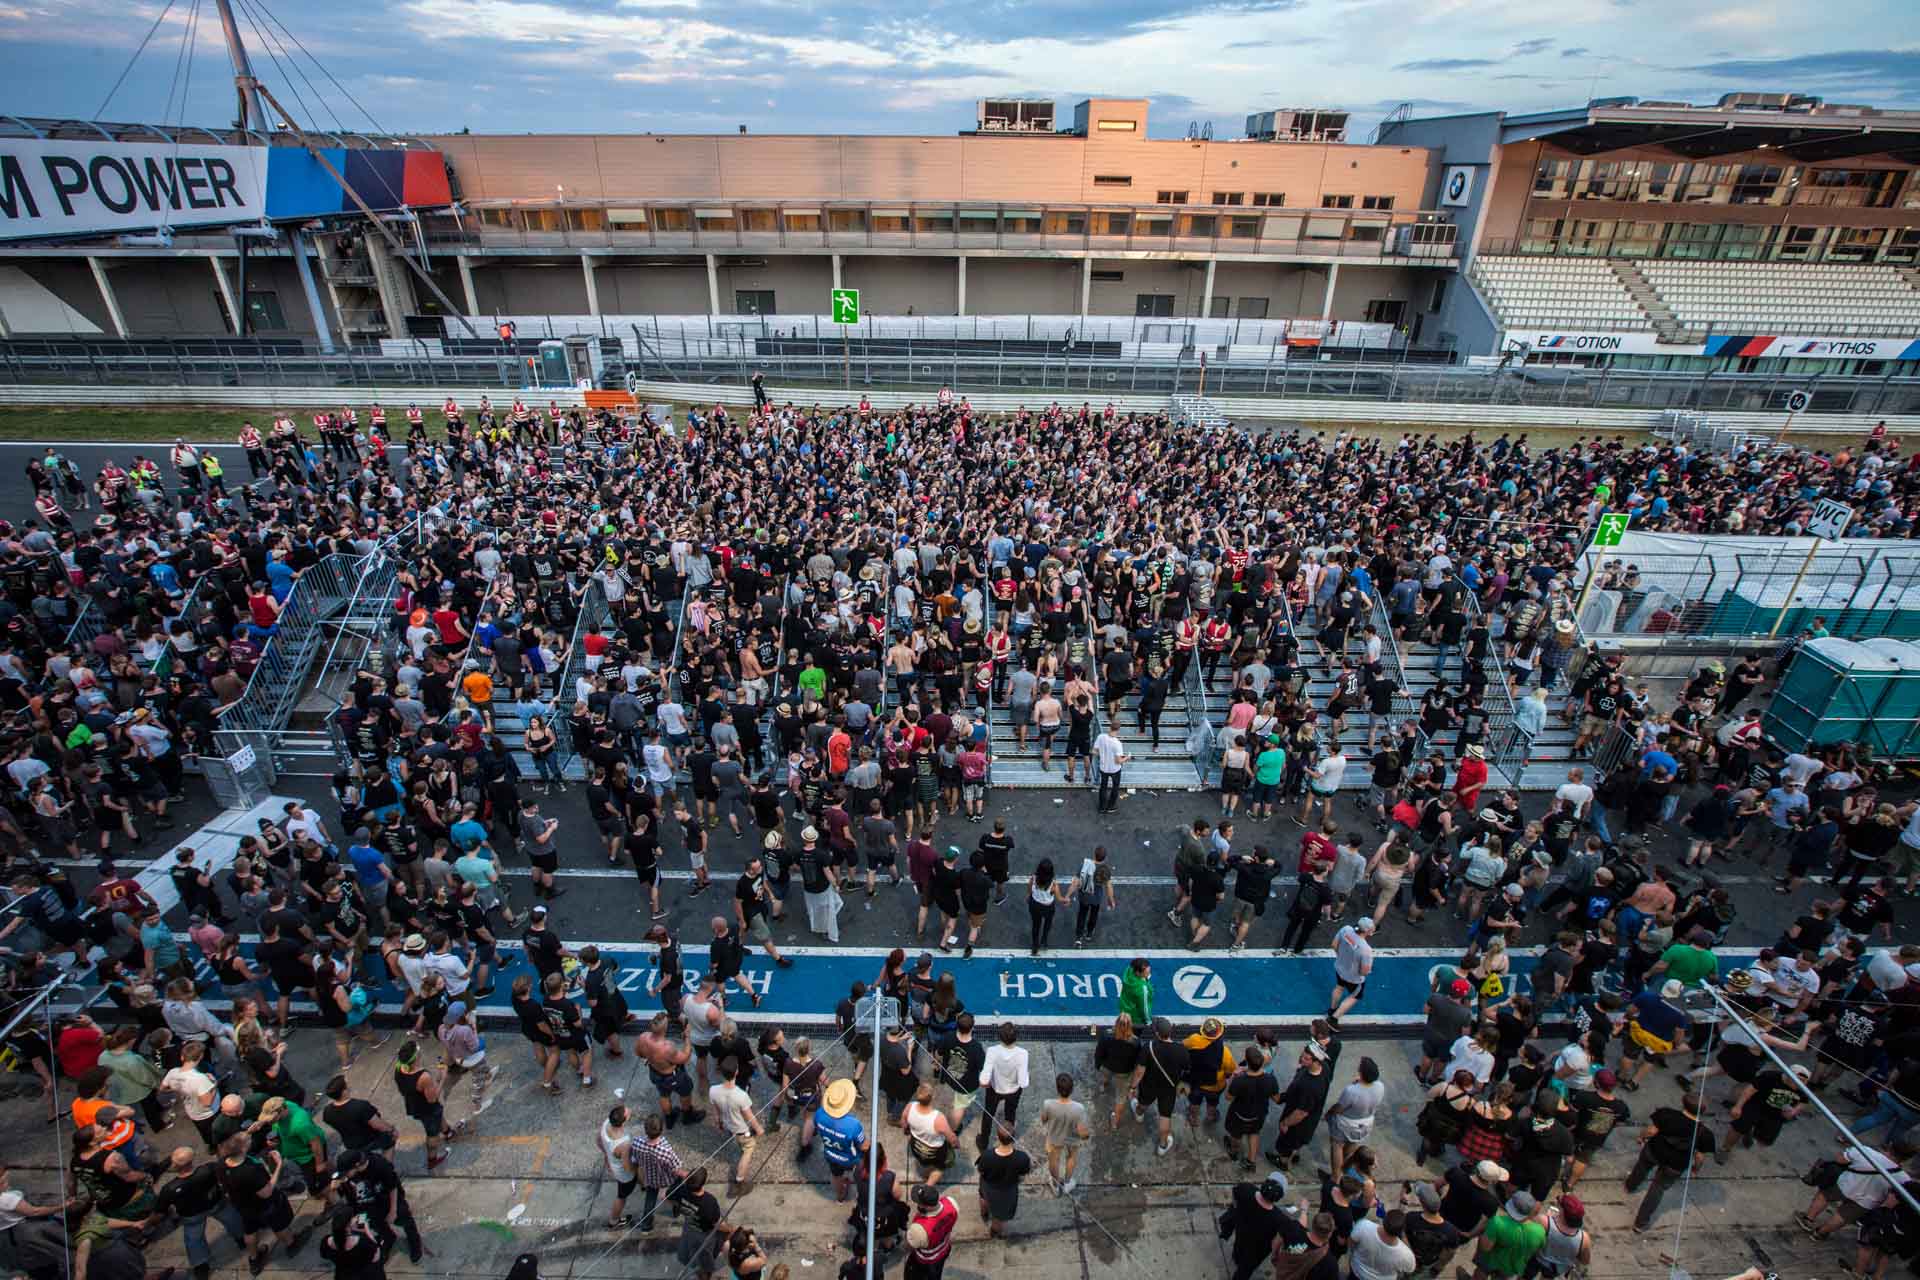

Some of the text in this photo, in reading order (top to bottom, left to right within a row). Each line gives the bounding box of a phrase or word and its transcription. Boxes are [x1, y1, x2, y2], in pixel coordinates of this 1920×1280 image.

[0, 155, 246, 219] M POWER
[1815, 342, 1876, 355] YTHOS
[1814, 502, 1846, 526] WC
[999, 972, 1123, 1000] URICH
